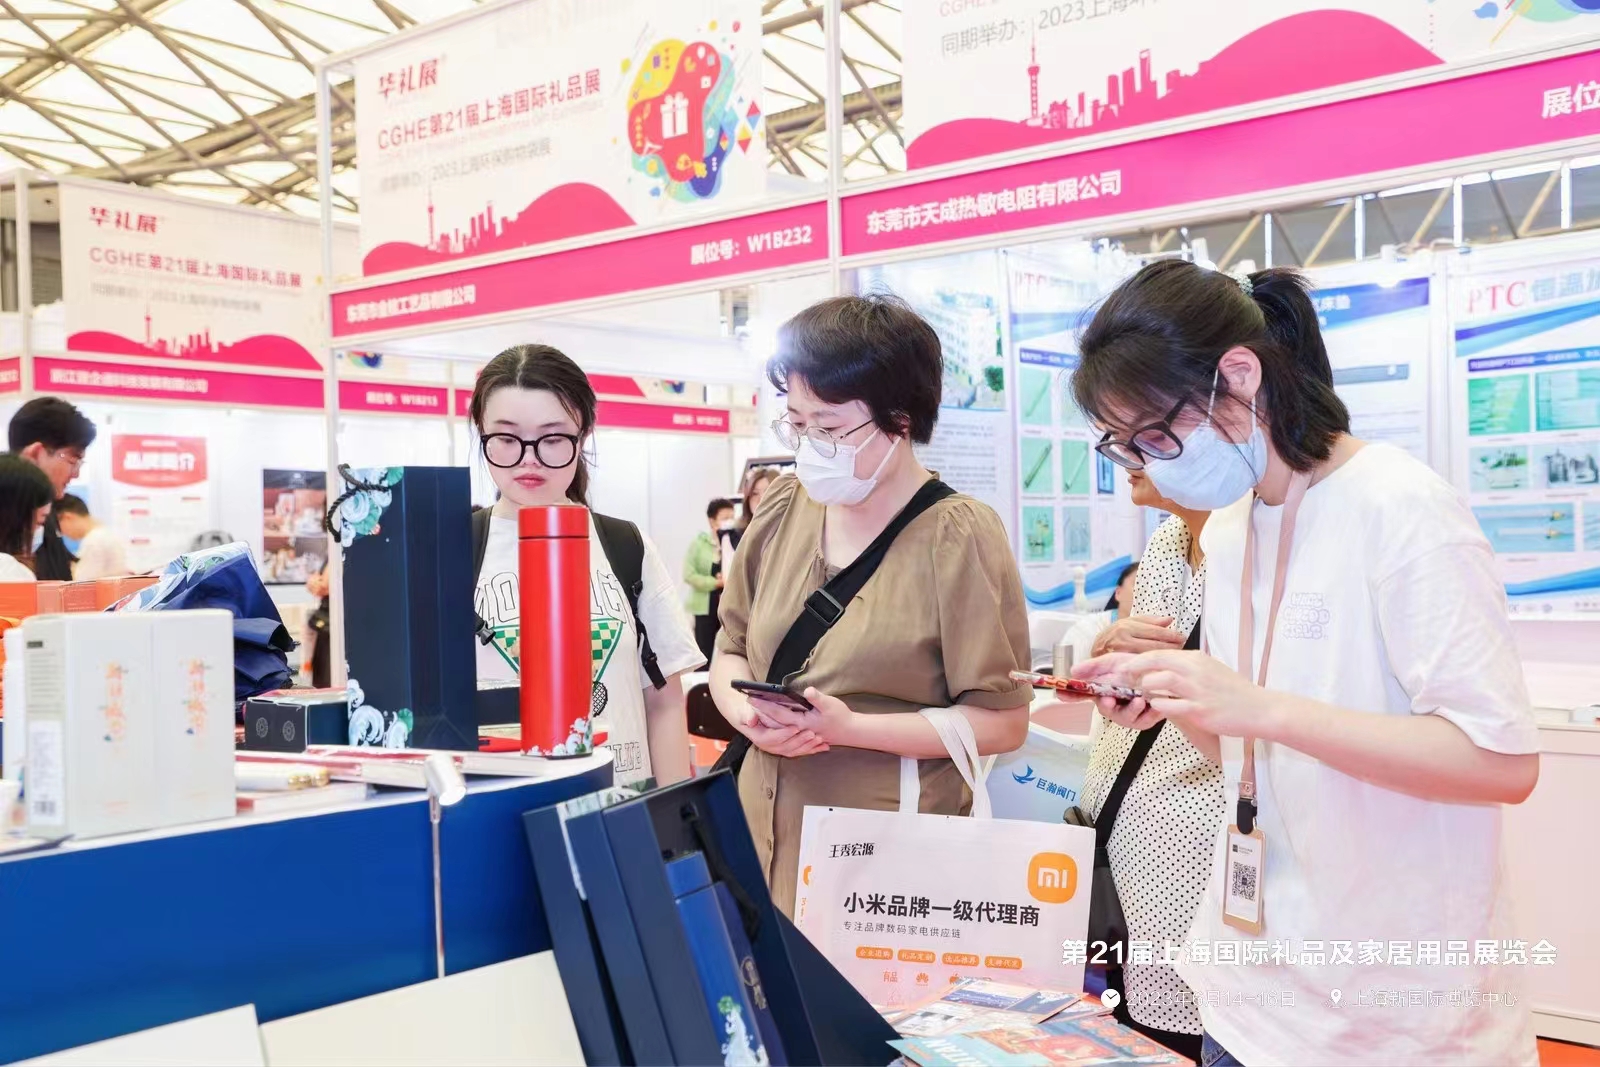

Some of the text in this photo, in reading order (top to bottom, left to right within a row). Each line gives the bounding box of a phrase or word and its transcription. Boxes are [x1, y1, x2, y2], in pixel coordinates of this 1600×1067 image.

[378, 58, 438, 99] 华礼展
[378, 68, 601, 149] CGHE第21届上海国际礼品展
[866, 169, 1122, 235] 东莞市天成热敏电阻有限公司
[90, 206, 157, 234] 华礼展
[746, 225, 812, 253] W1B232
[89, 247, 302, 288] CGHE第21届上海国际礼品展
[1036, 778, 1077, 802] 巨瀚阀门
[828, 842, 875, 858] 王秀宏源
[843, 891, 1041, 927] 小米品牌一级代理商
[843, 920, 962, 939] 专注品牌数码家电供应链
[883, 971, 898, 983] 有品
